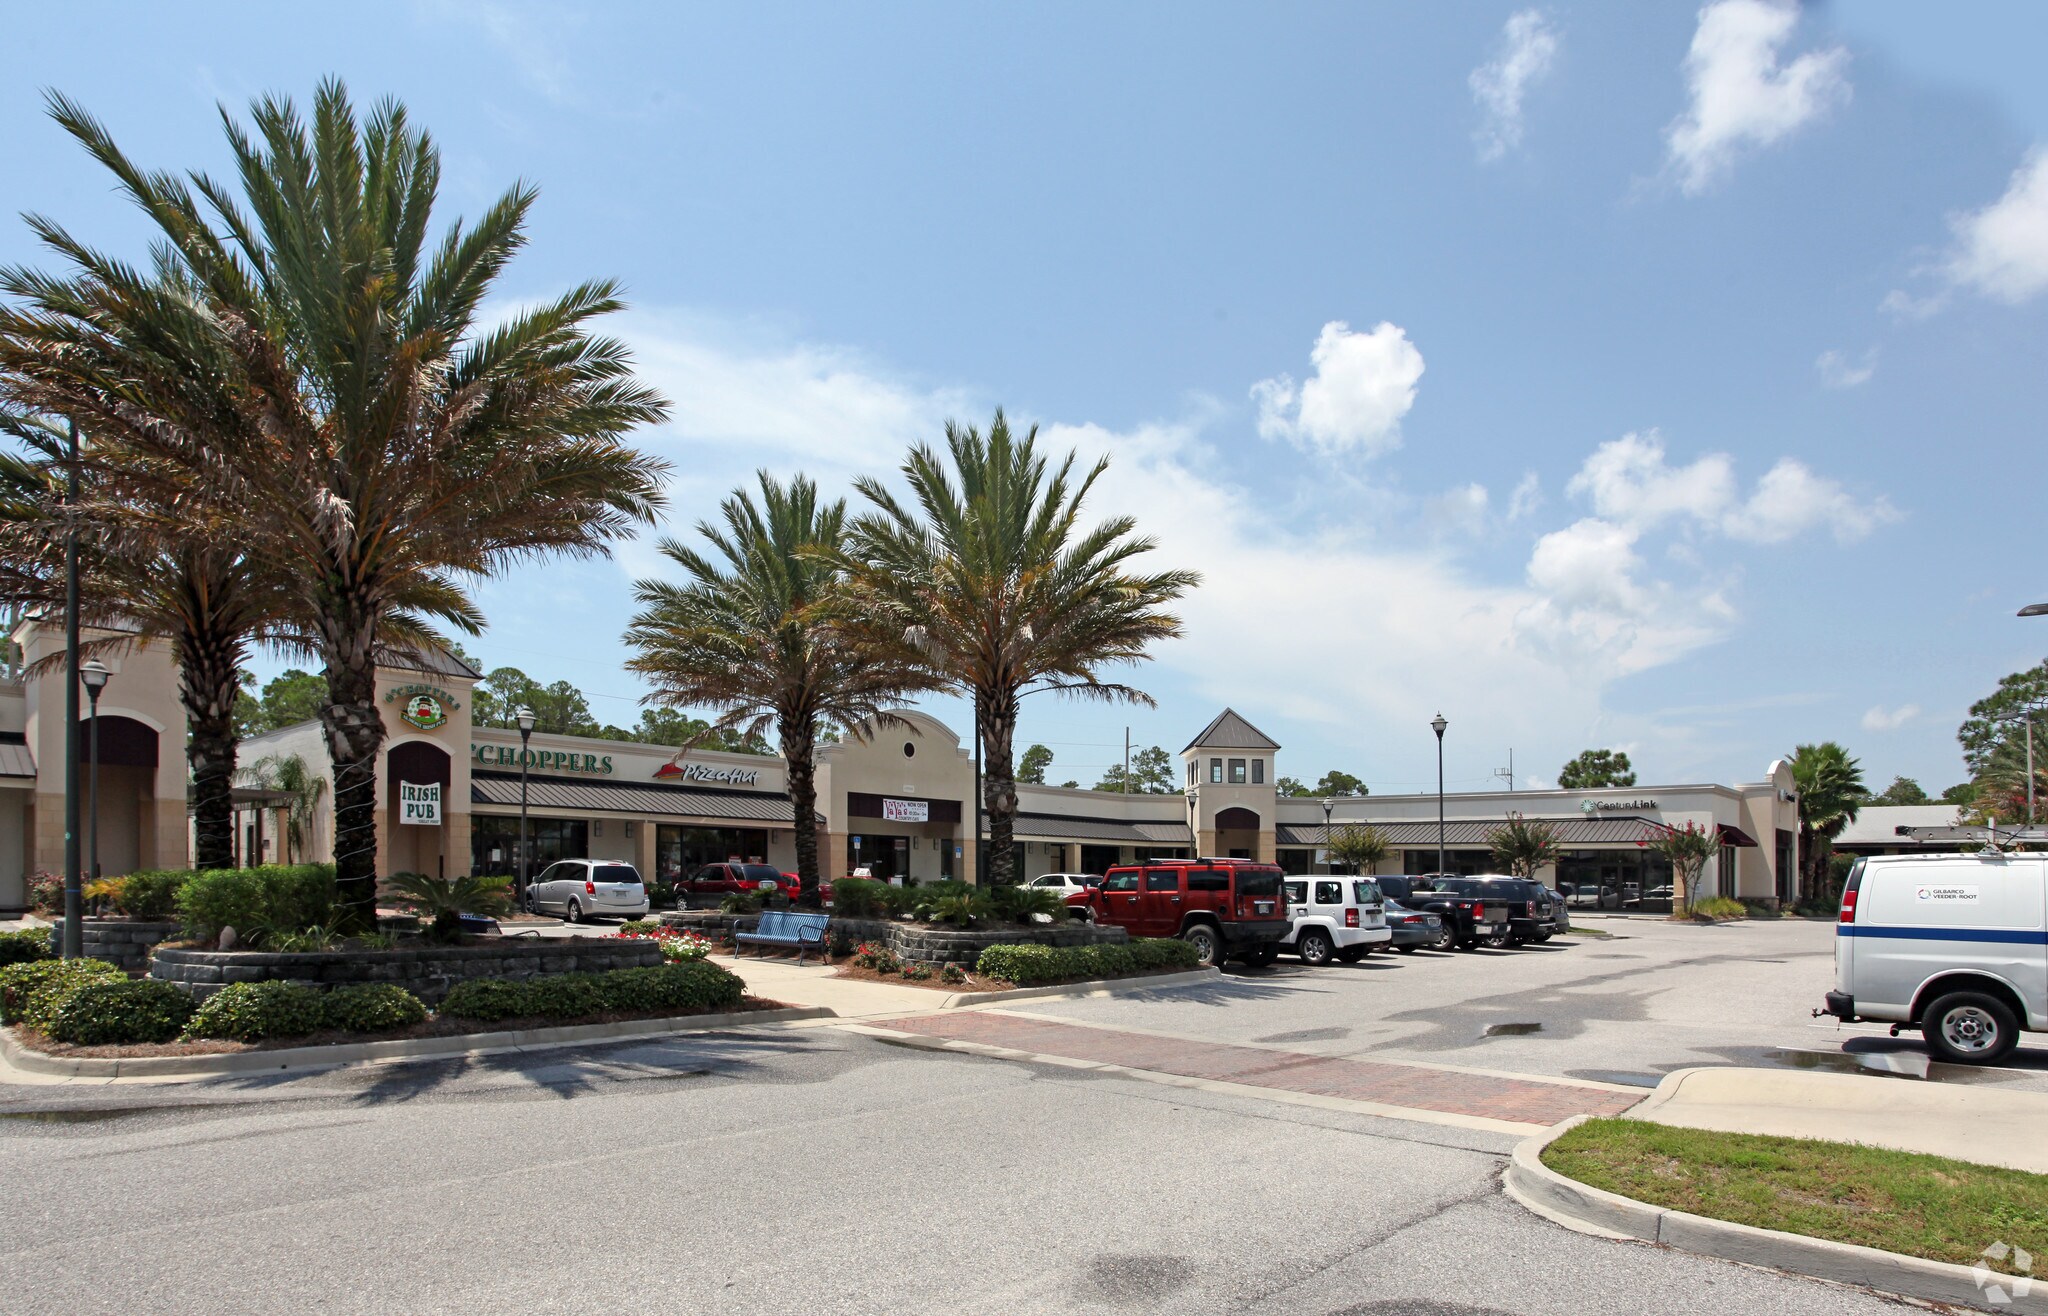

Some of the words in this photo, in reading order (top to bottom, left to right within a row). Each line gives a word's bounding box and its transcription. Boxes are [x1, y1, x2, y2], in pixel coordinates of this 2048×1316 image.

[471, 743, 613, 775] 'CHOPPERS
[402, 785, 439, 802] IRISH
[406, 803, 435, 819] PUB
[1596, 800, 1657, 811] CenturyLink
